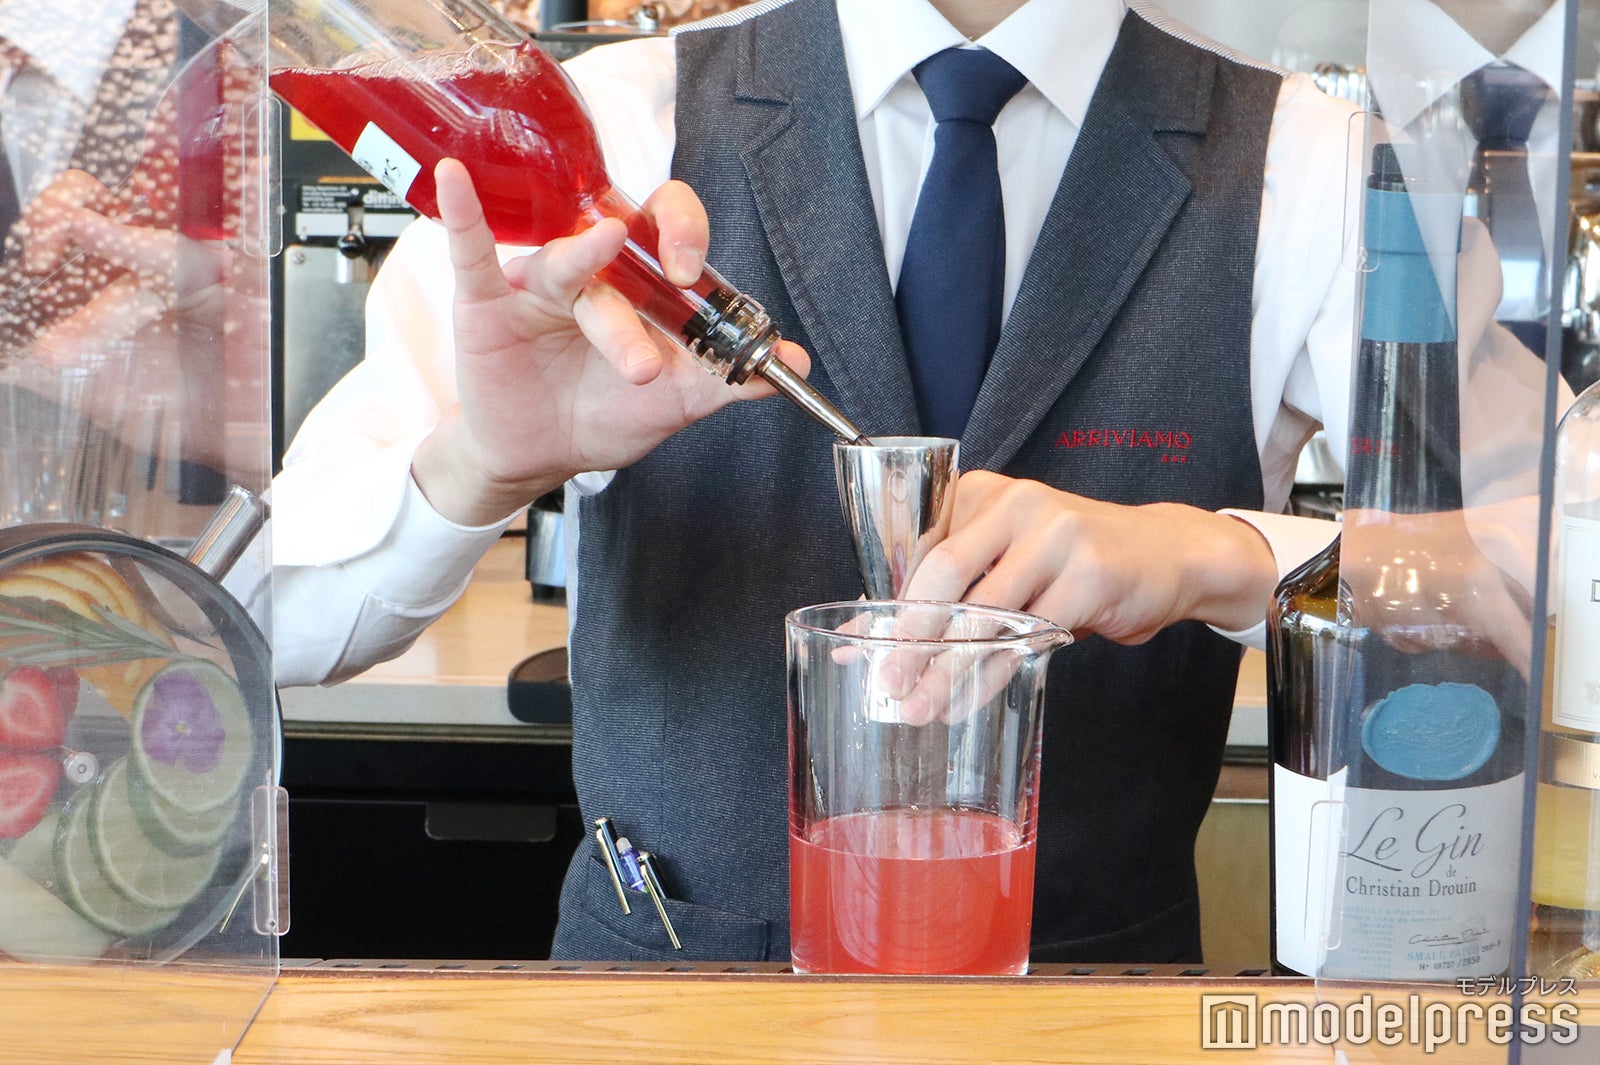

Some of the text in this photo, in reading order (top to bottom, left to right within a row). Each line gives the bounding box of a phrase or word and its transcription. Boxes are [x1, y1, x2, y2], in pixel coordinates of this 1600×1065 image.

[1055, 429, 1192, 449] ARRIVIAMO
[1339, 803, 1484, 879] Le Gin
[1446, 865, 1457, 878] de
[1346, 876, 1477, 897] Christian Drouin
